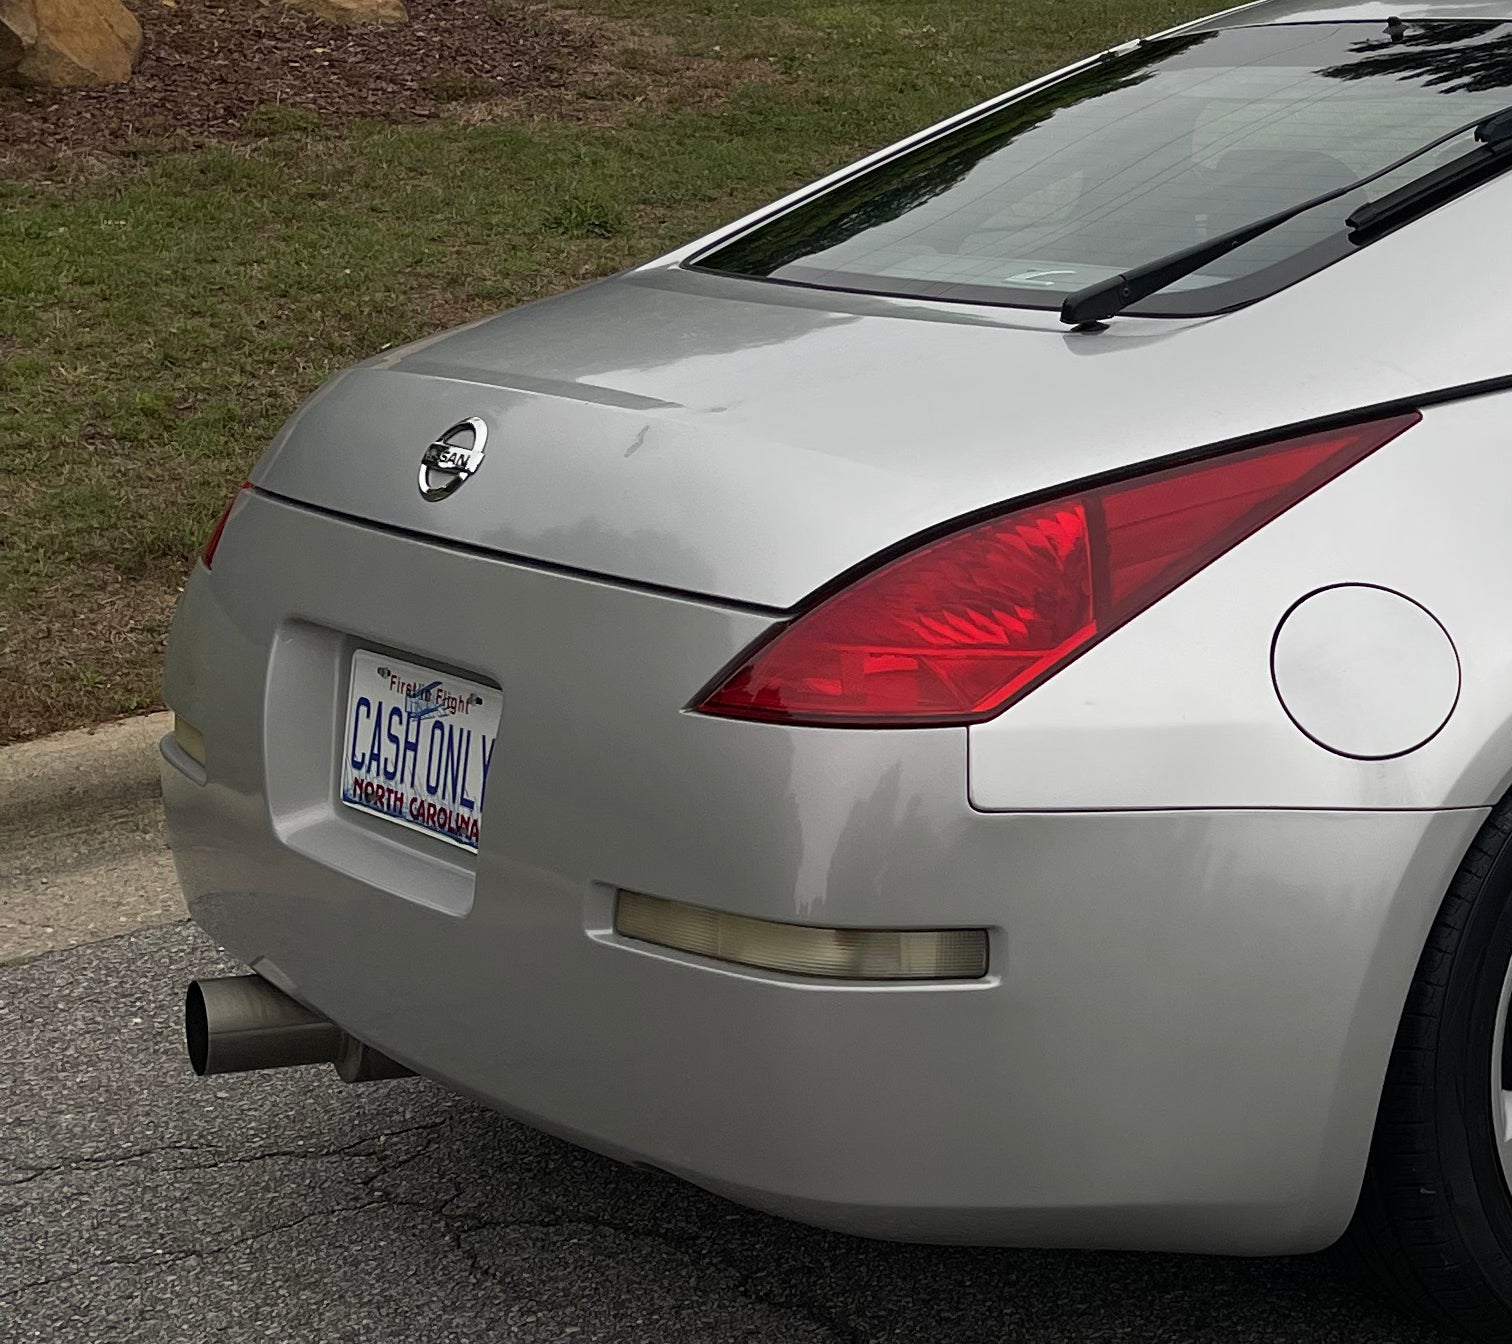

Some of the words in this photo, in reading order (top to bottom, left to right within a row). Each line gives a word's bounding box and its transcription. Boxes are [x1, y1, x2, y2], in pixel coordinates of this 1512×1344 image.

[426, 450, 471, 467] SAN
[389, 674, 417, 699] First
[436, 688, 471, 716] Flight
[351, 696, 421, 789] CASH
[426, 720, 497, 813] ONLY
[353, 777, 404, 815] NORTH
[409, 797, 479, 842] CAROLINA
